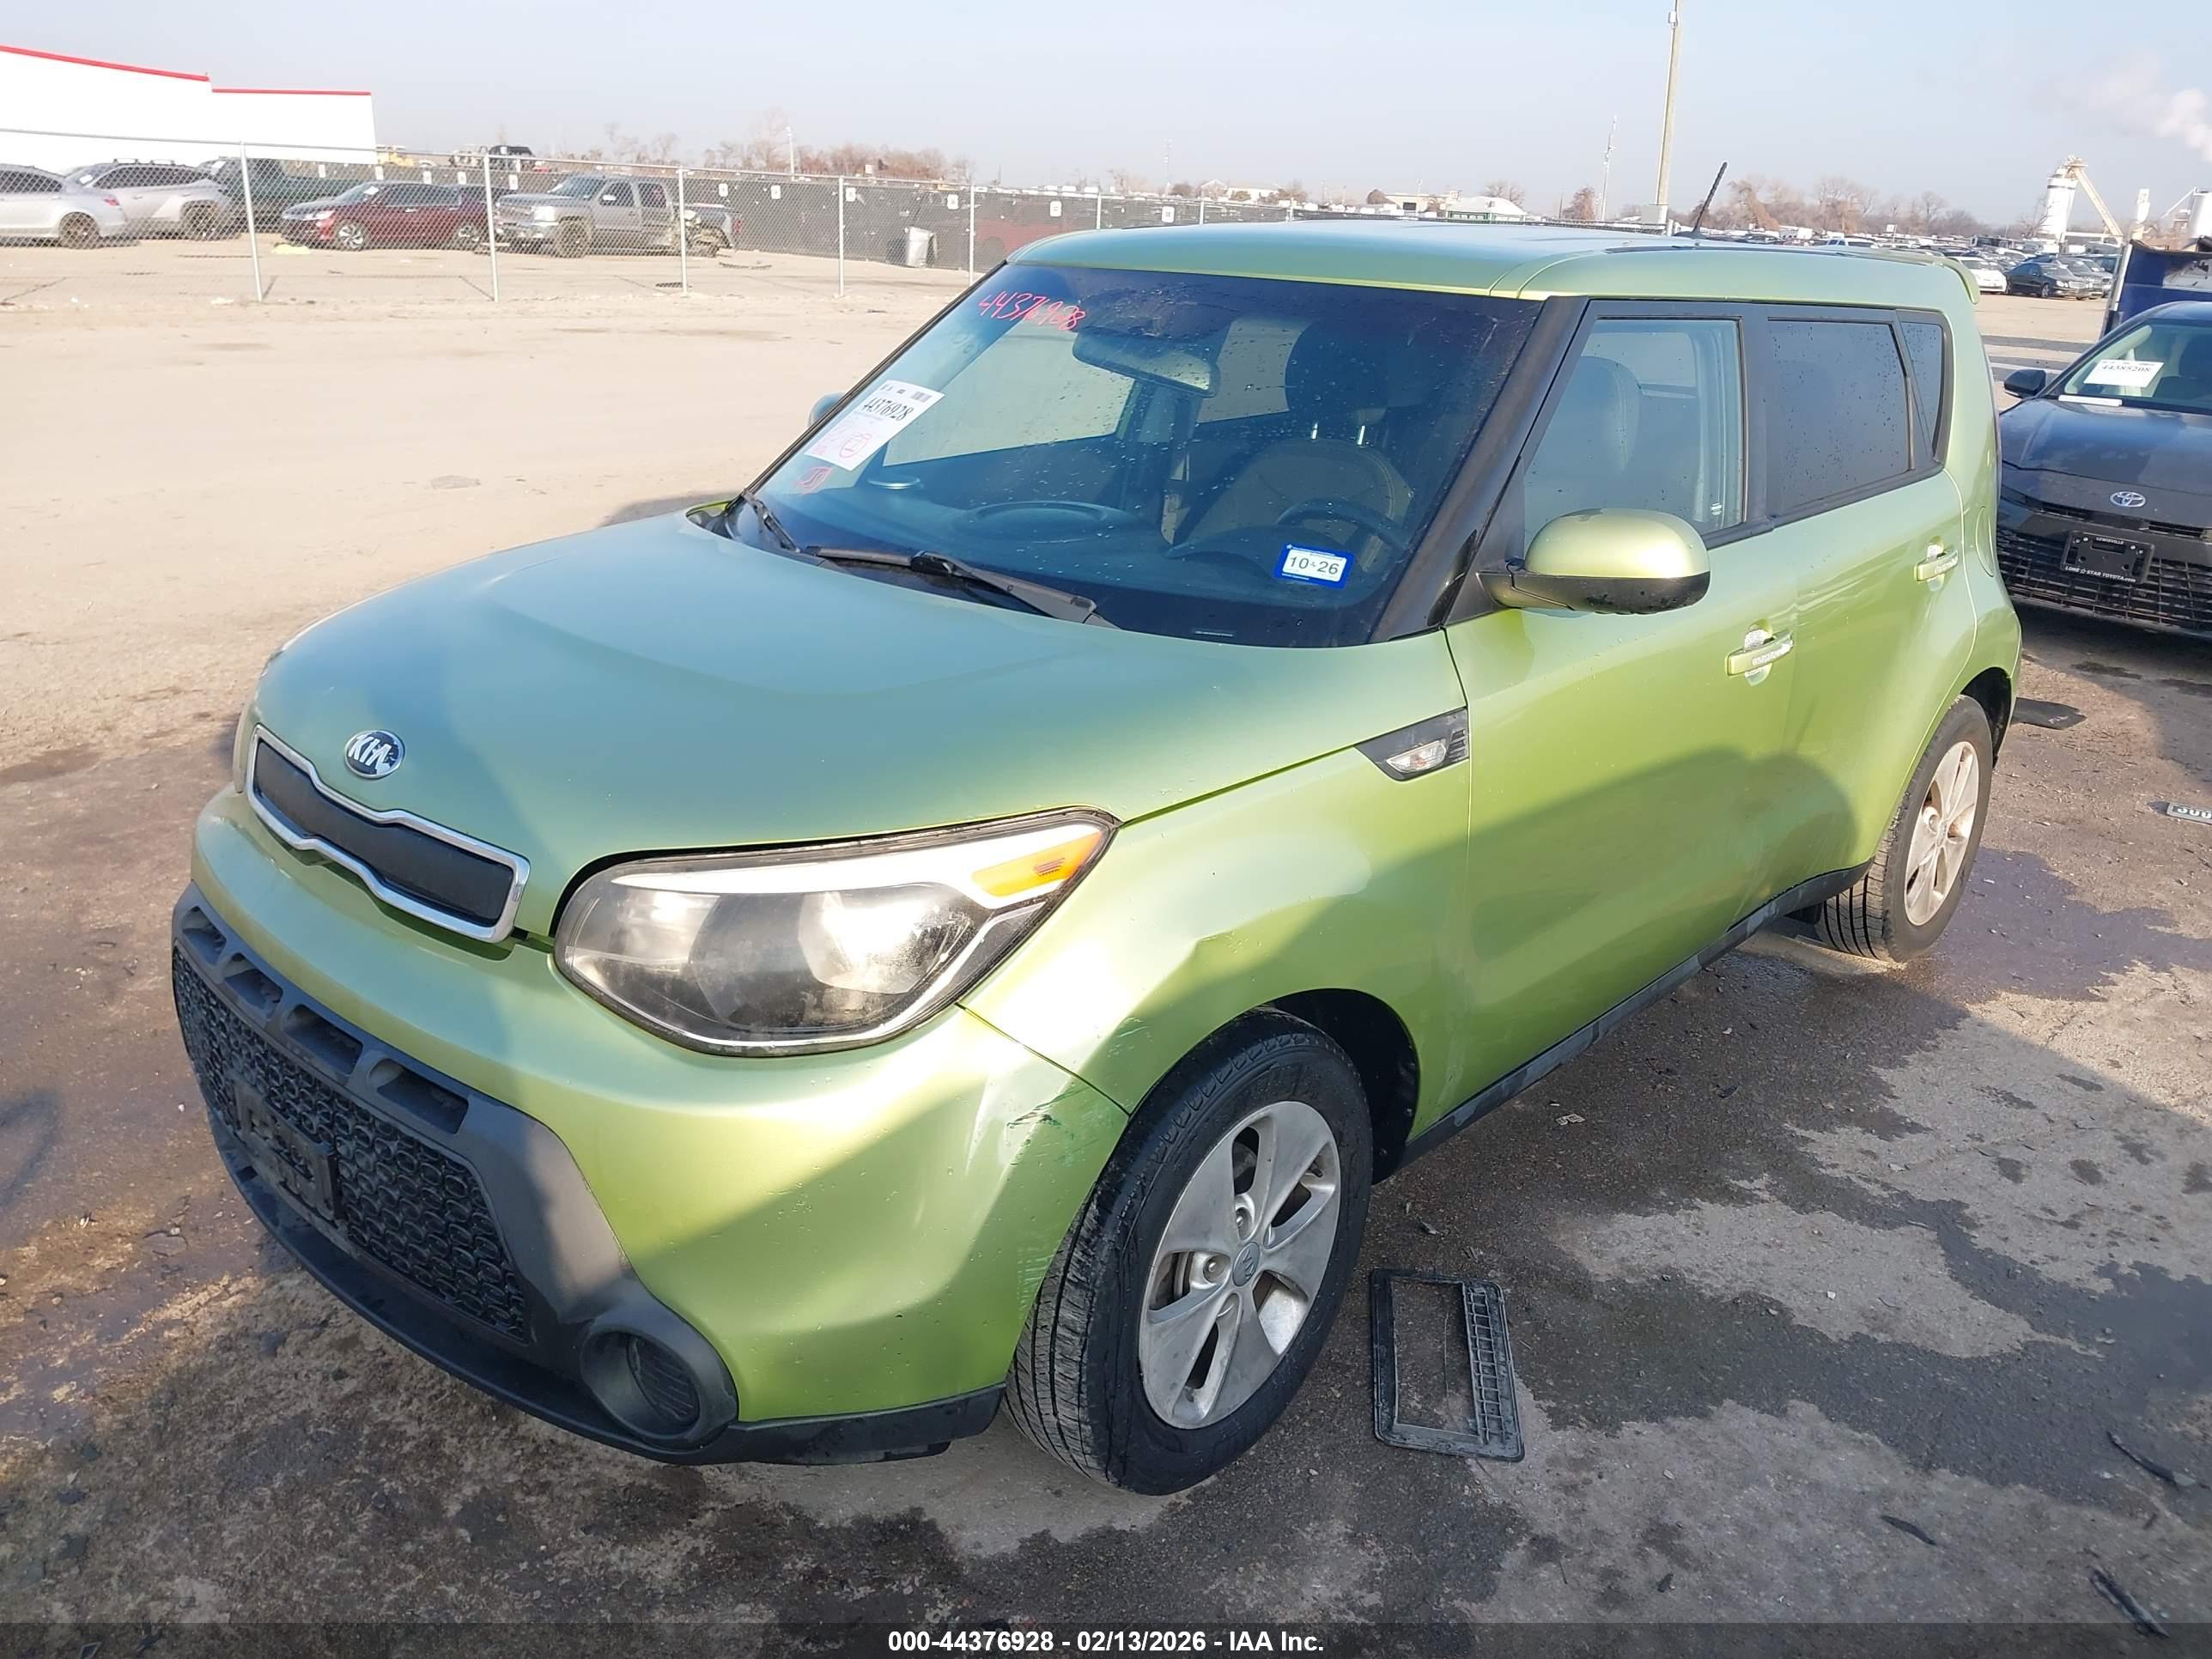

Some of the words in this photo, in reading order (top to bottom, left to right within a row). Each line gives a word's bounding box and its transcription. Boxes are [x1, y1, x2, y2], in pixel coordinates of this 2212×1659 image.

[978, 290, 1086, 330] 44376928
[861, 397, 915, 421] 44376928
[1290, 556, 1310, 569] 10
[1316, 561, 1340, 575] 26
[2064, 565, 2079, 574] LONE
[348, 732, 392, 770] KIA
